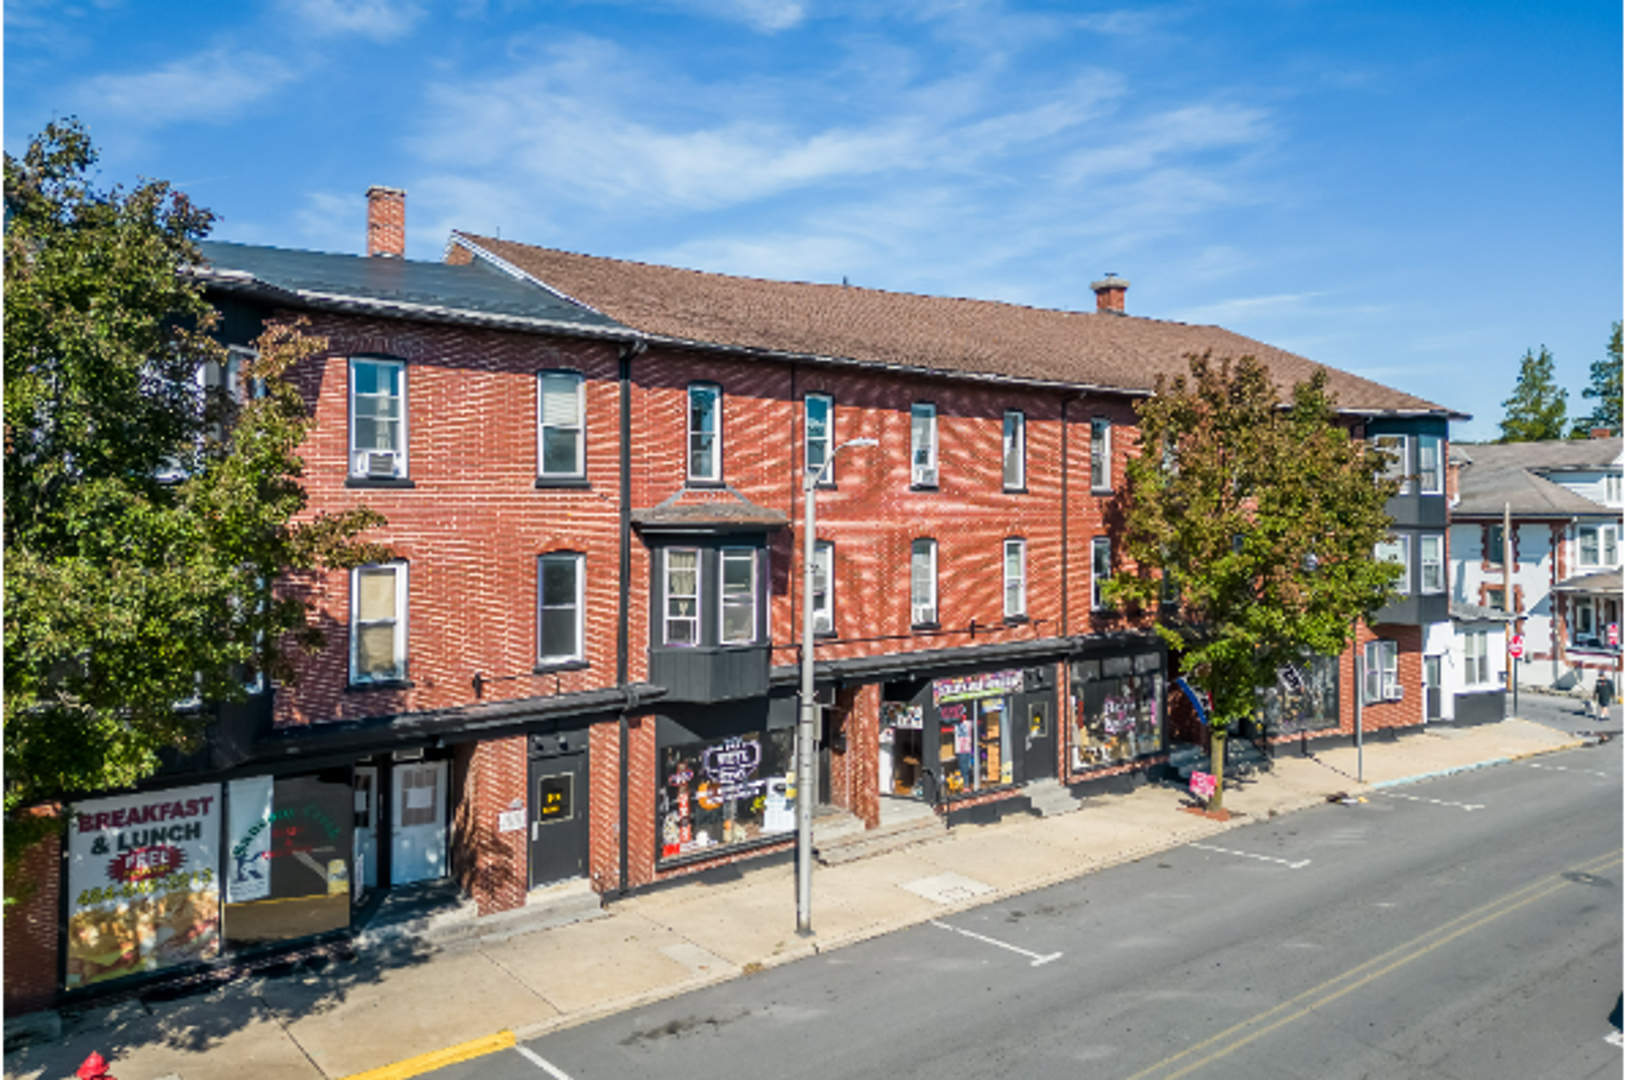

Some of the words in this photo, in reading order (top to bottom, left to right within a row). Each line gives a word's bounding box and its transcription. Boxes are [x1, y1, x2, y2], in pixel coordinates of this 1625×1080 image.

[79, 797, 213, 833] BREAKFAST
[91, 836, 109, 855] &
[118, 822, 202, 852] LUNCH
